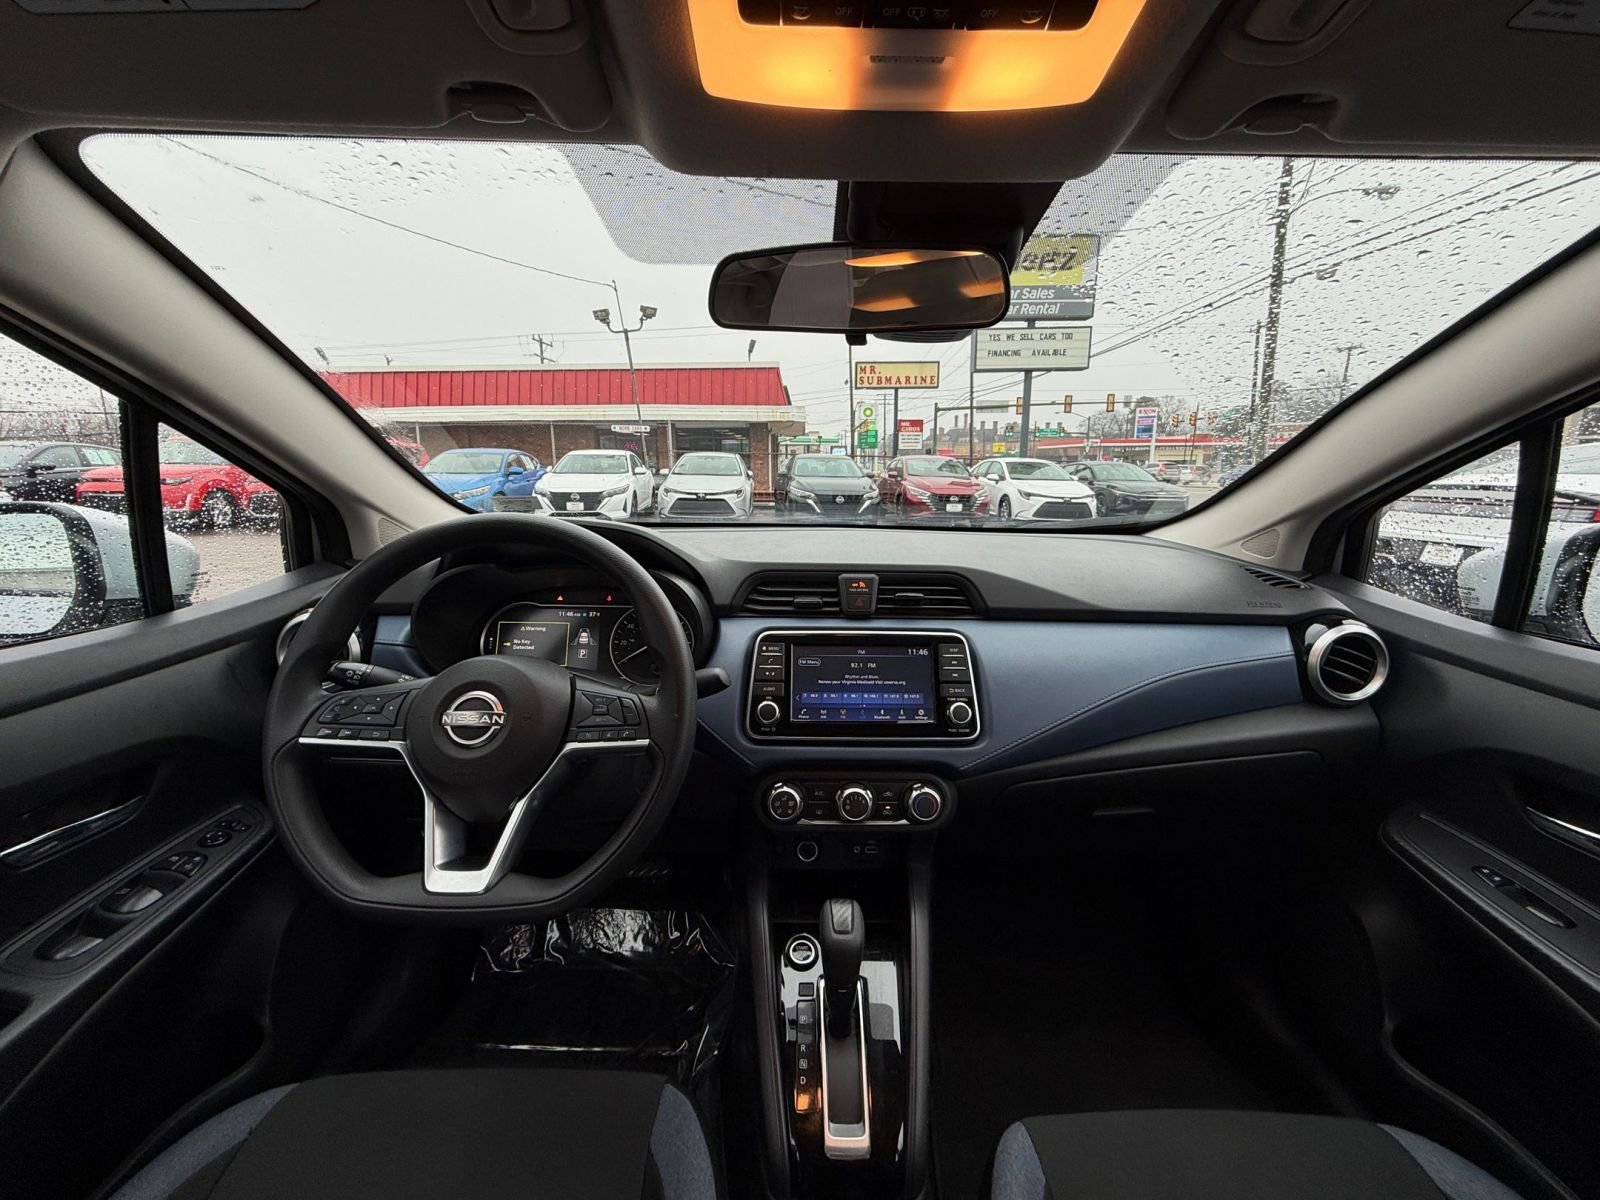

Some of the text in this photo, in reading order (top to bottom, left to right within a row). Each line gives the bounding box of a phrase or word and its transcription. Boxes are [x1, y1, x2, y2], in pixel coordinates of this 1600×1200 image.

[834, 6, 853, 16] OFF
[882, 7, 900, 17] OFF
[979, 8, 999, 18] OFF
[1021, 287, 1055, 299] Sales
[1020, 303, 1060, 315] Rental
[988, 332, 1074, 342] YES WE SELL CARS TOO
[987, 348, 1067, 358] FINANCING AVAILABLE
[859, 365, 882, 375] MR.
[858, 375, 936, 385] SUBMARINE
[907, 648, 929, 656] 11:46
[441, 714, 504, 724] NISSAN
[800, 1044, 806, 1052] R
[800, 1076, 806, 1085] D
